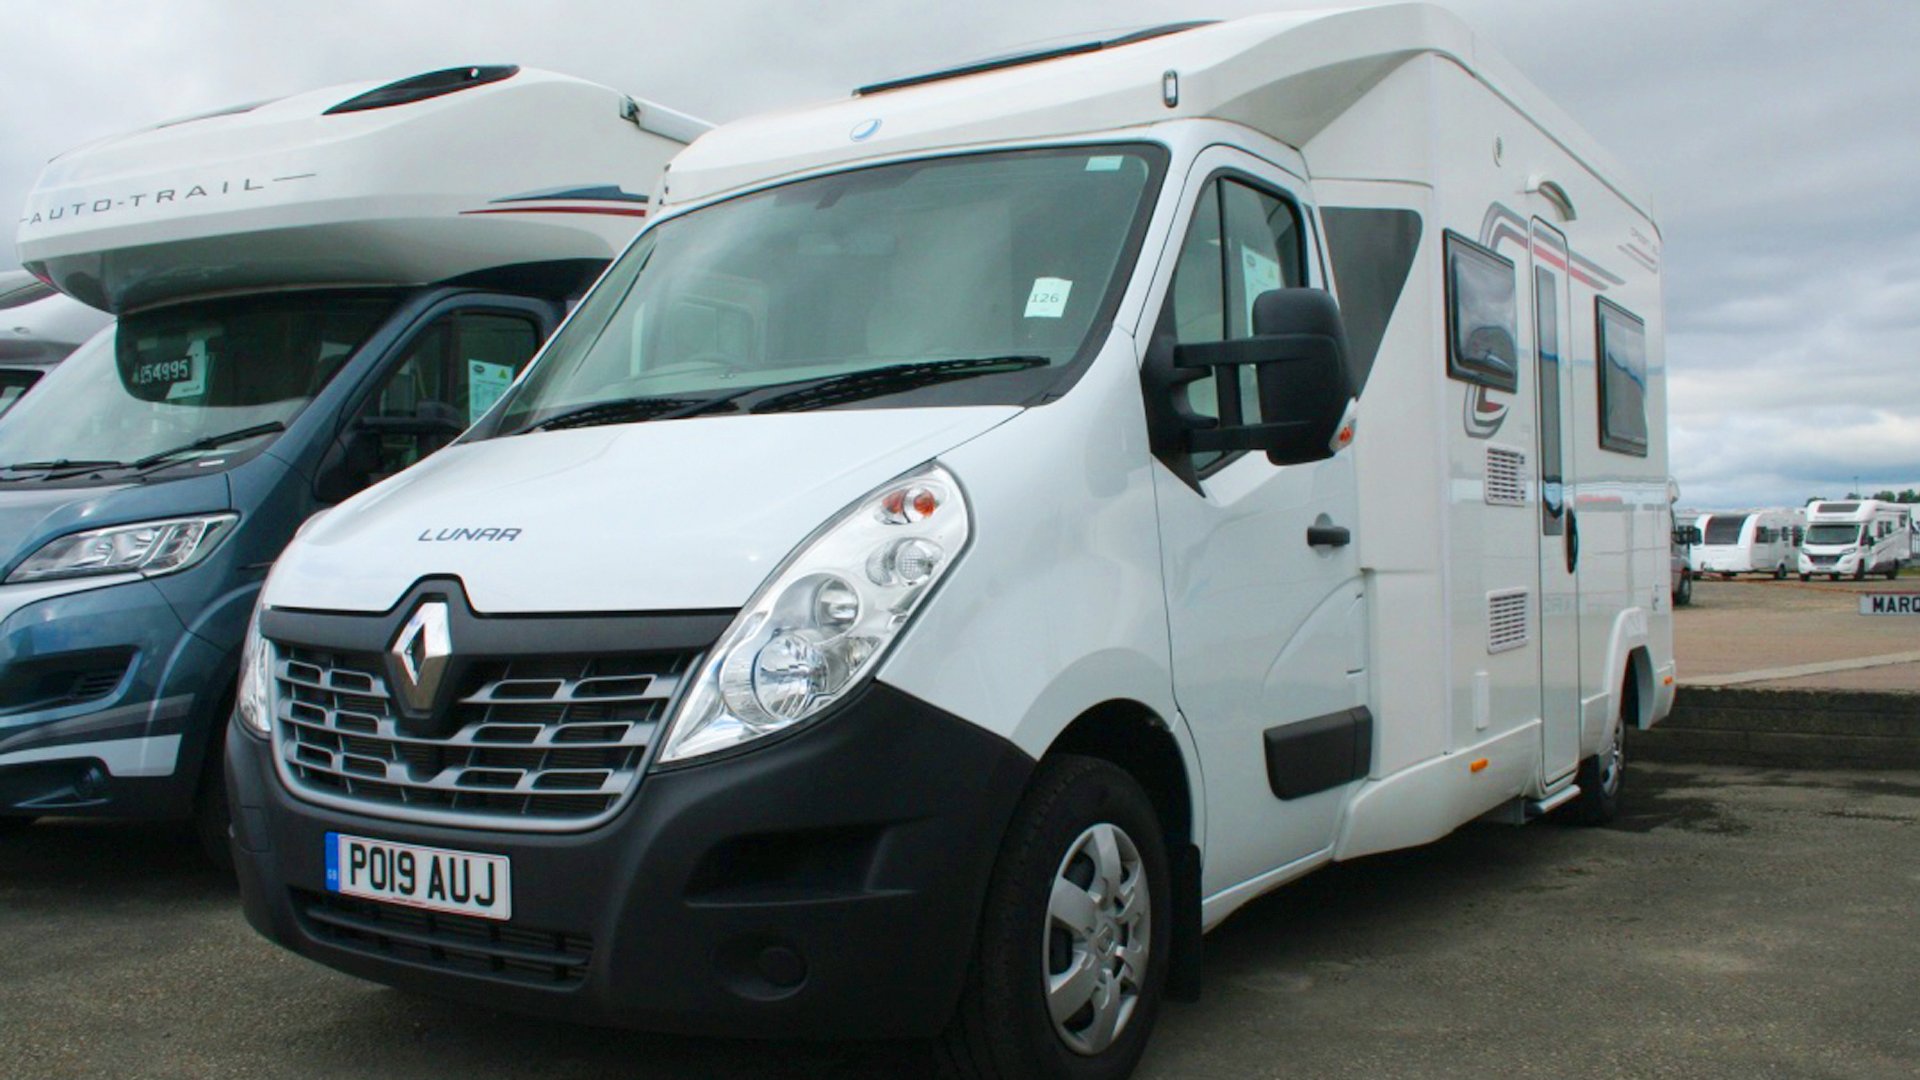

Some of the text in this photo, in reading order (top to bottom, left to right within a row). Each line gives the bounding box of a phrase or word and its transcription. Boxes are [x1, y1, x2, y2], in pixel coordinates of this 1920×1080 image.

[30, 178, 264, 225] AUTO-TRAIL
[1030, 292, 1060, 304] 126
[417, 527, 523, 542] LUNAR
[350, 842, 496, 908] PO19 AUJ
